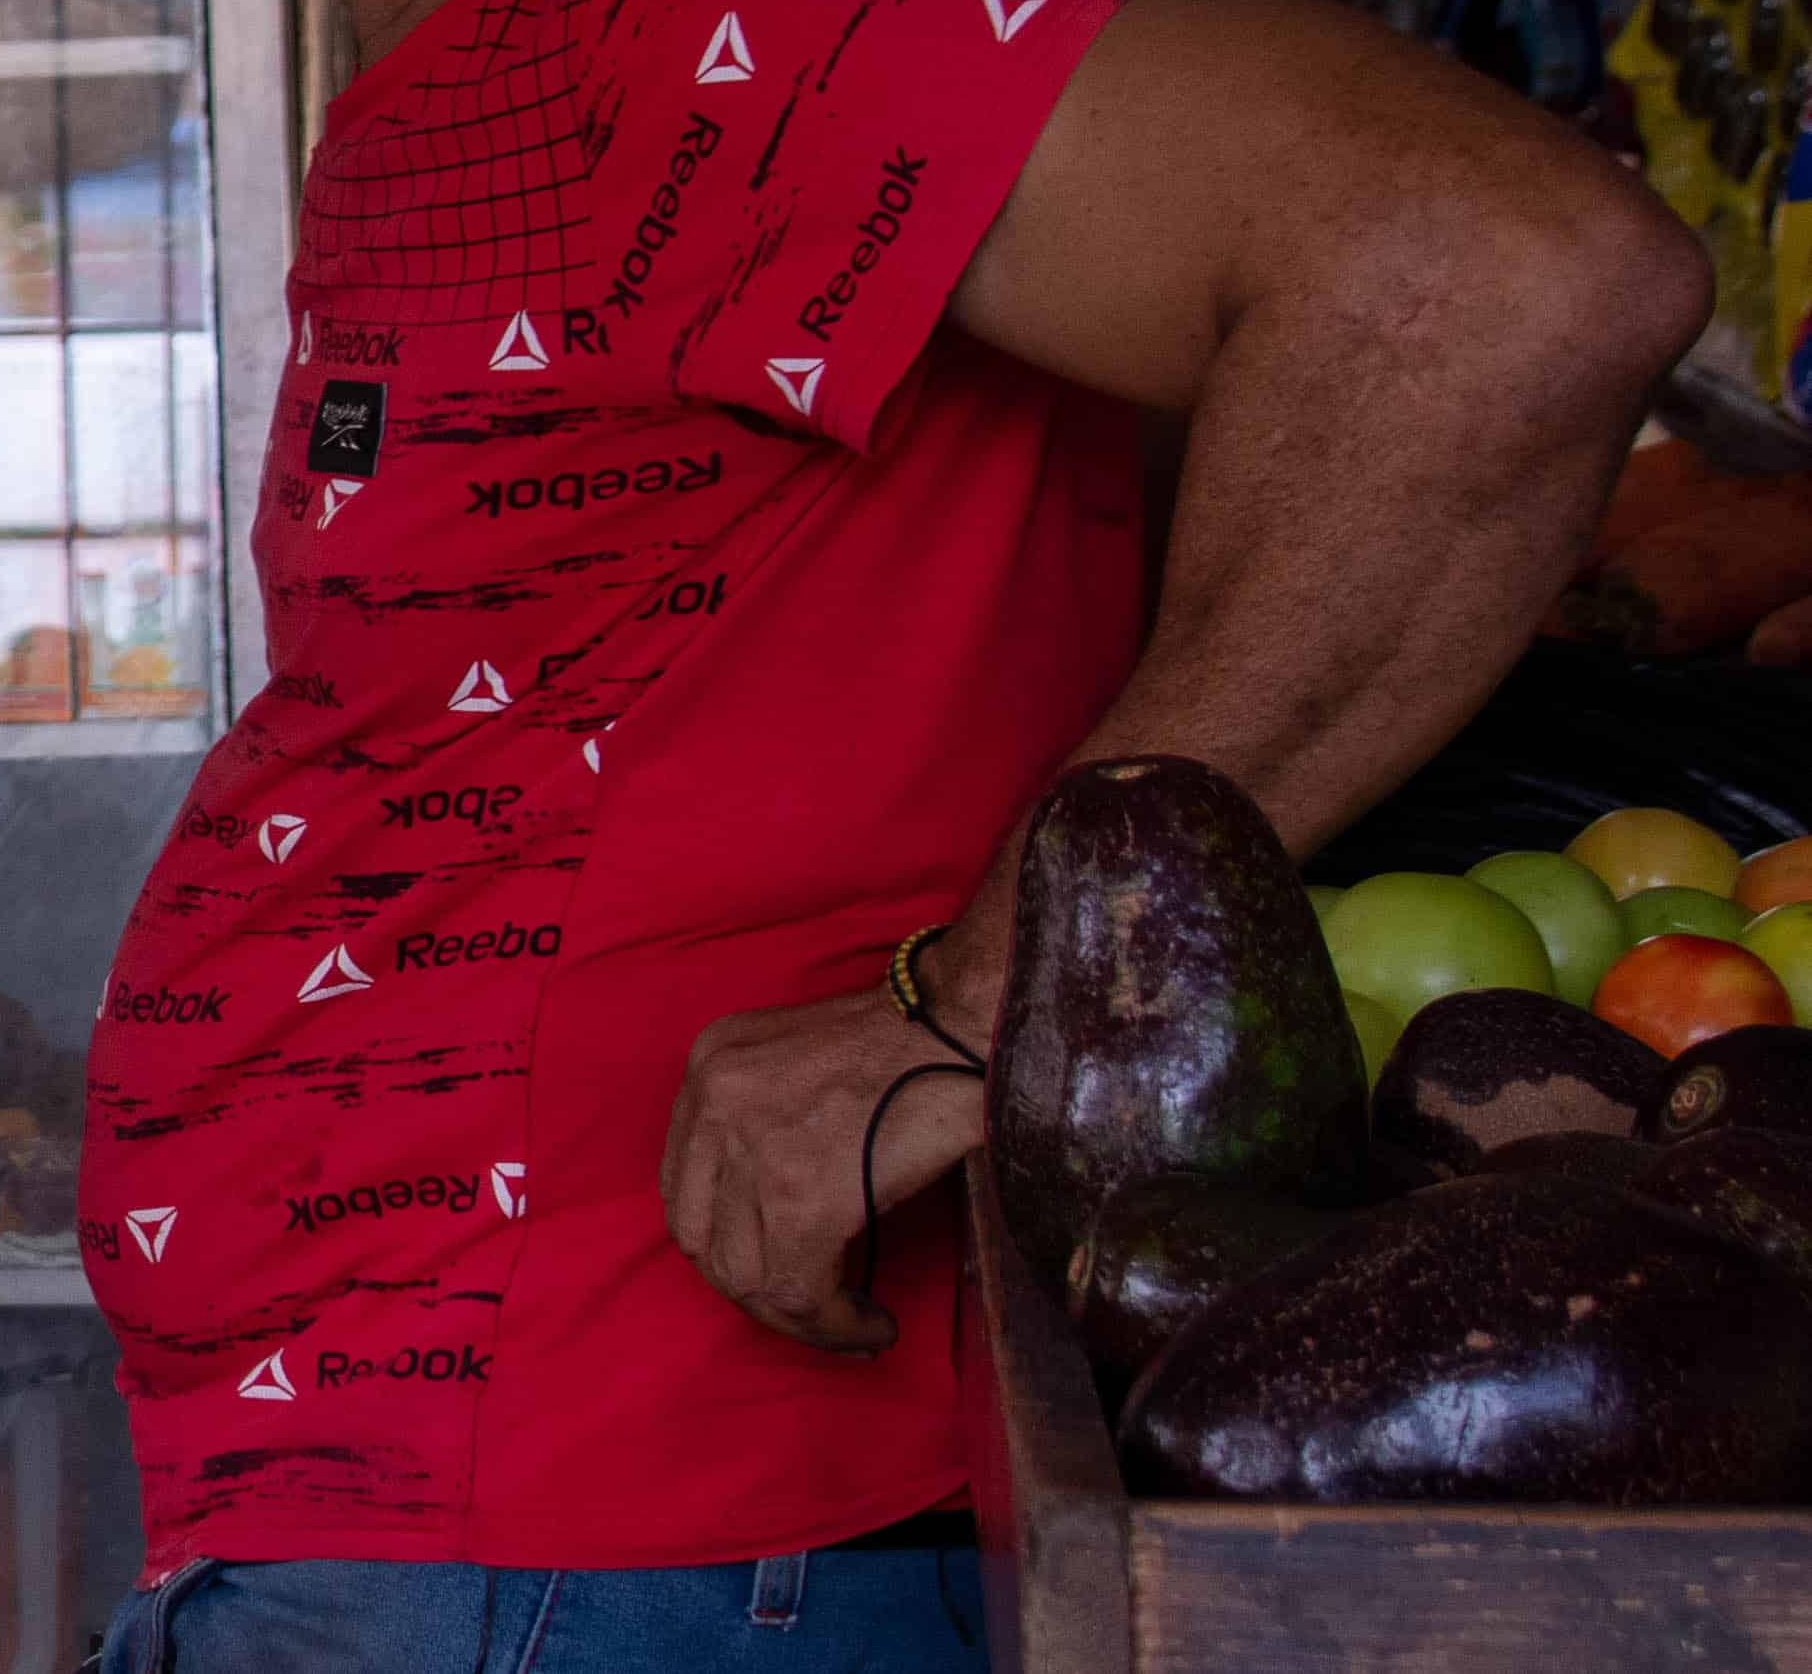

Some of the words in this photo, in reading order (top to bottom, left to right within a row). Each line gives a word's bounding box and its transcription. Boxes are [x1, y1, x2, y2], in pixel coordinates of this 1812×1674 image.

[604, 109, 724, 318] Reebok
[796, 143, 929, 342] Reebok
[464, 452, 723, 519] Reebok
[395, 920, 562, 973] Reebo
[287, 1173, 480, 1231] Reebok
